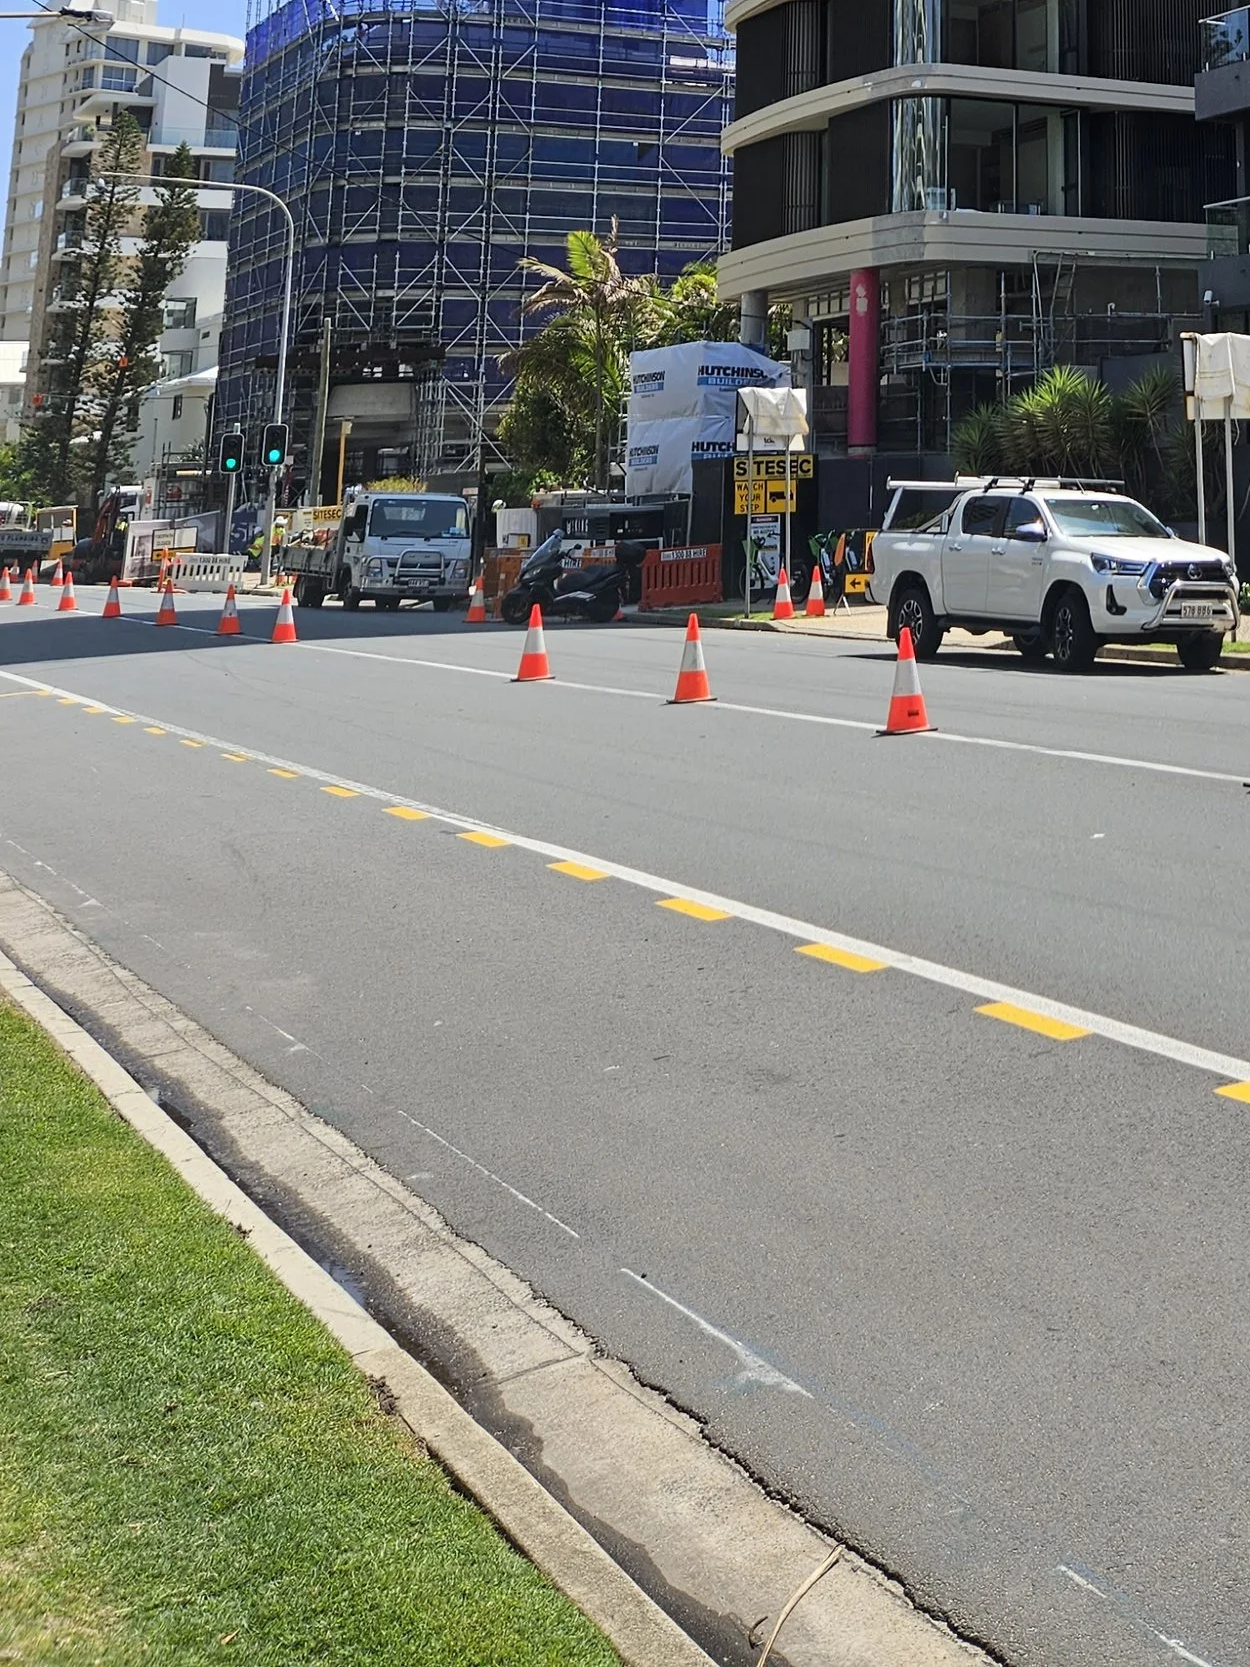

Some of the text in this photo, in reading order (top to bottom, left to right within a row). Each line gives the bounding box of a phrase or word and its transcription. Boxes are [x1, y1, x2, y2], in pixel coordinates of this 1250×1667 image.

[698, 365, 768, 379] HUTCHINS
[736, 459, 811, 476] STESEC
[737, 482, 763, 491] WACH
[313, 509, 341, 520] SITESEC
